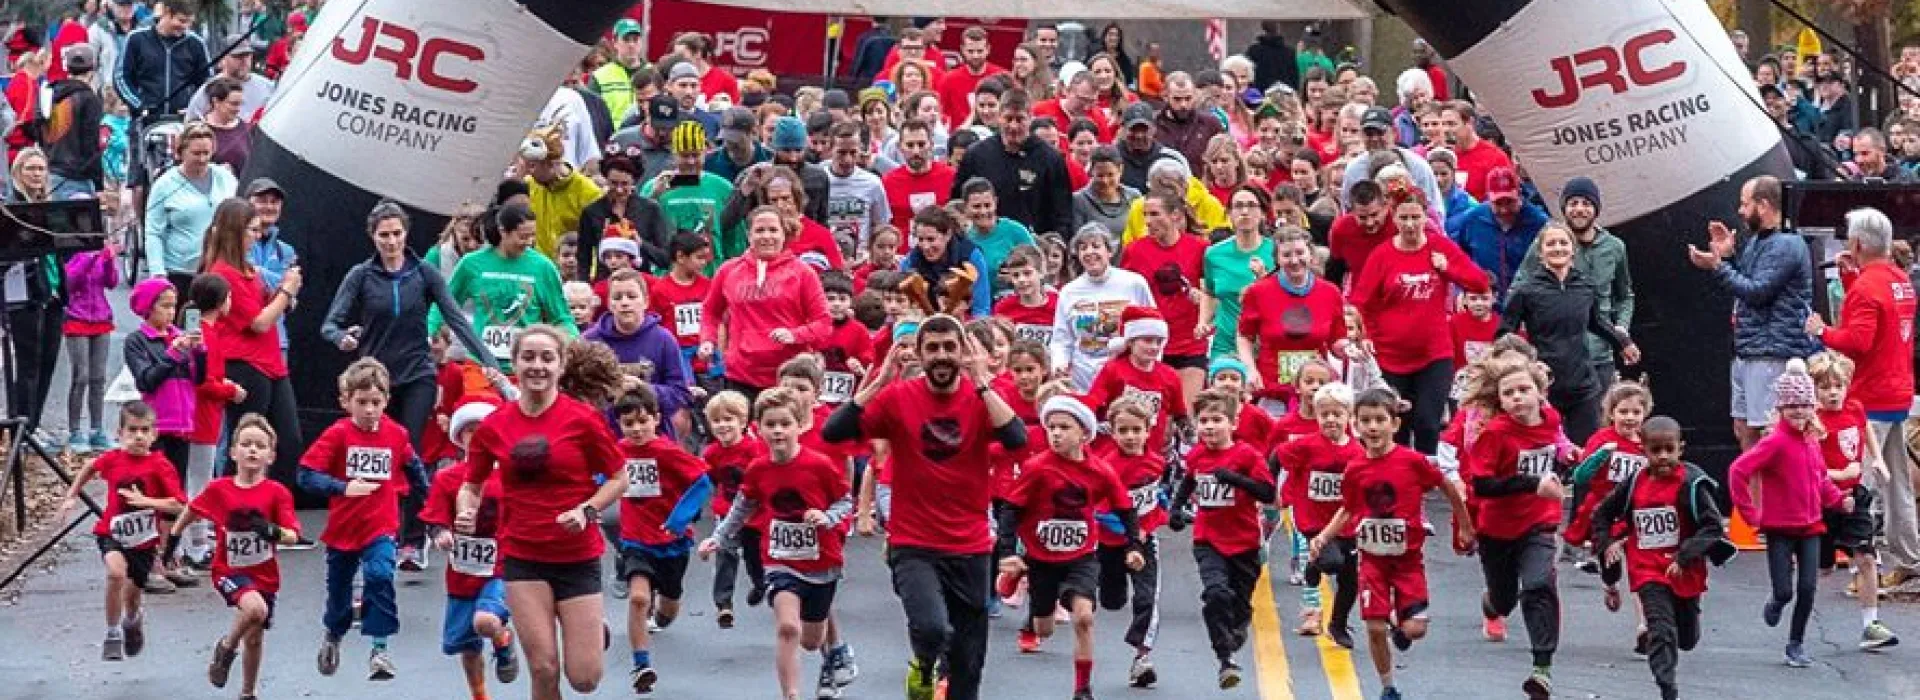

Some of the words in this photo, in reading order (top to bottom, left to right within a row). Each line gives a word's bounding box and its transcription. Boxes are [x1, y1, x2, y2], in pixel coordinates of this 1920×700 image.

[332, 16, 485, 93] JRC
[1531, 29, 1687, 108] JRC
[317, 80, 386, 115] JONES
[391, 102, 478, 134] RACING
[1552, 118, 1623, 146] JONES
[1627, 94, 1711, 133] RACING
[336, 111, 442, 151] COMPANY
[1584, 124, 1688, 165] COMPANY
[348, 453, 391, 474] 4250
[112, 515, 154, 537] 4017
[773, 526, 816, 548] 4039
[1040, 526, 1083, 548] 4085
[1359, 524, 1404, 544] 4165
